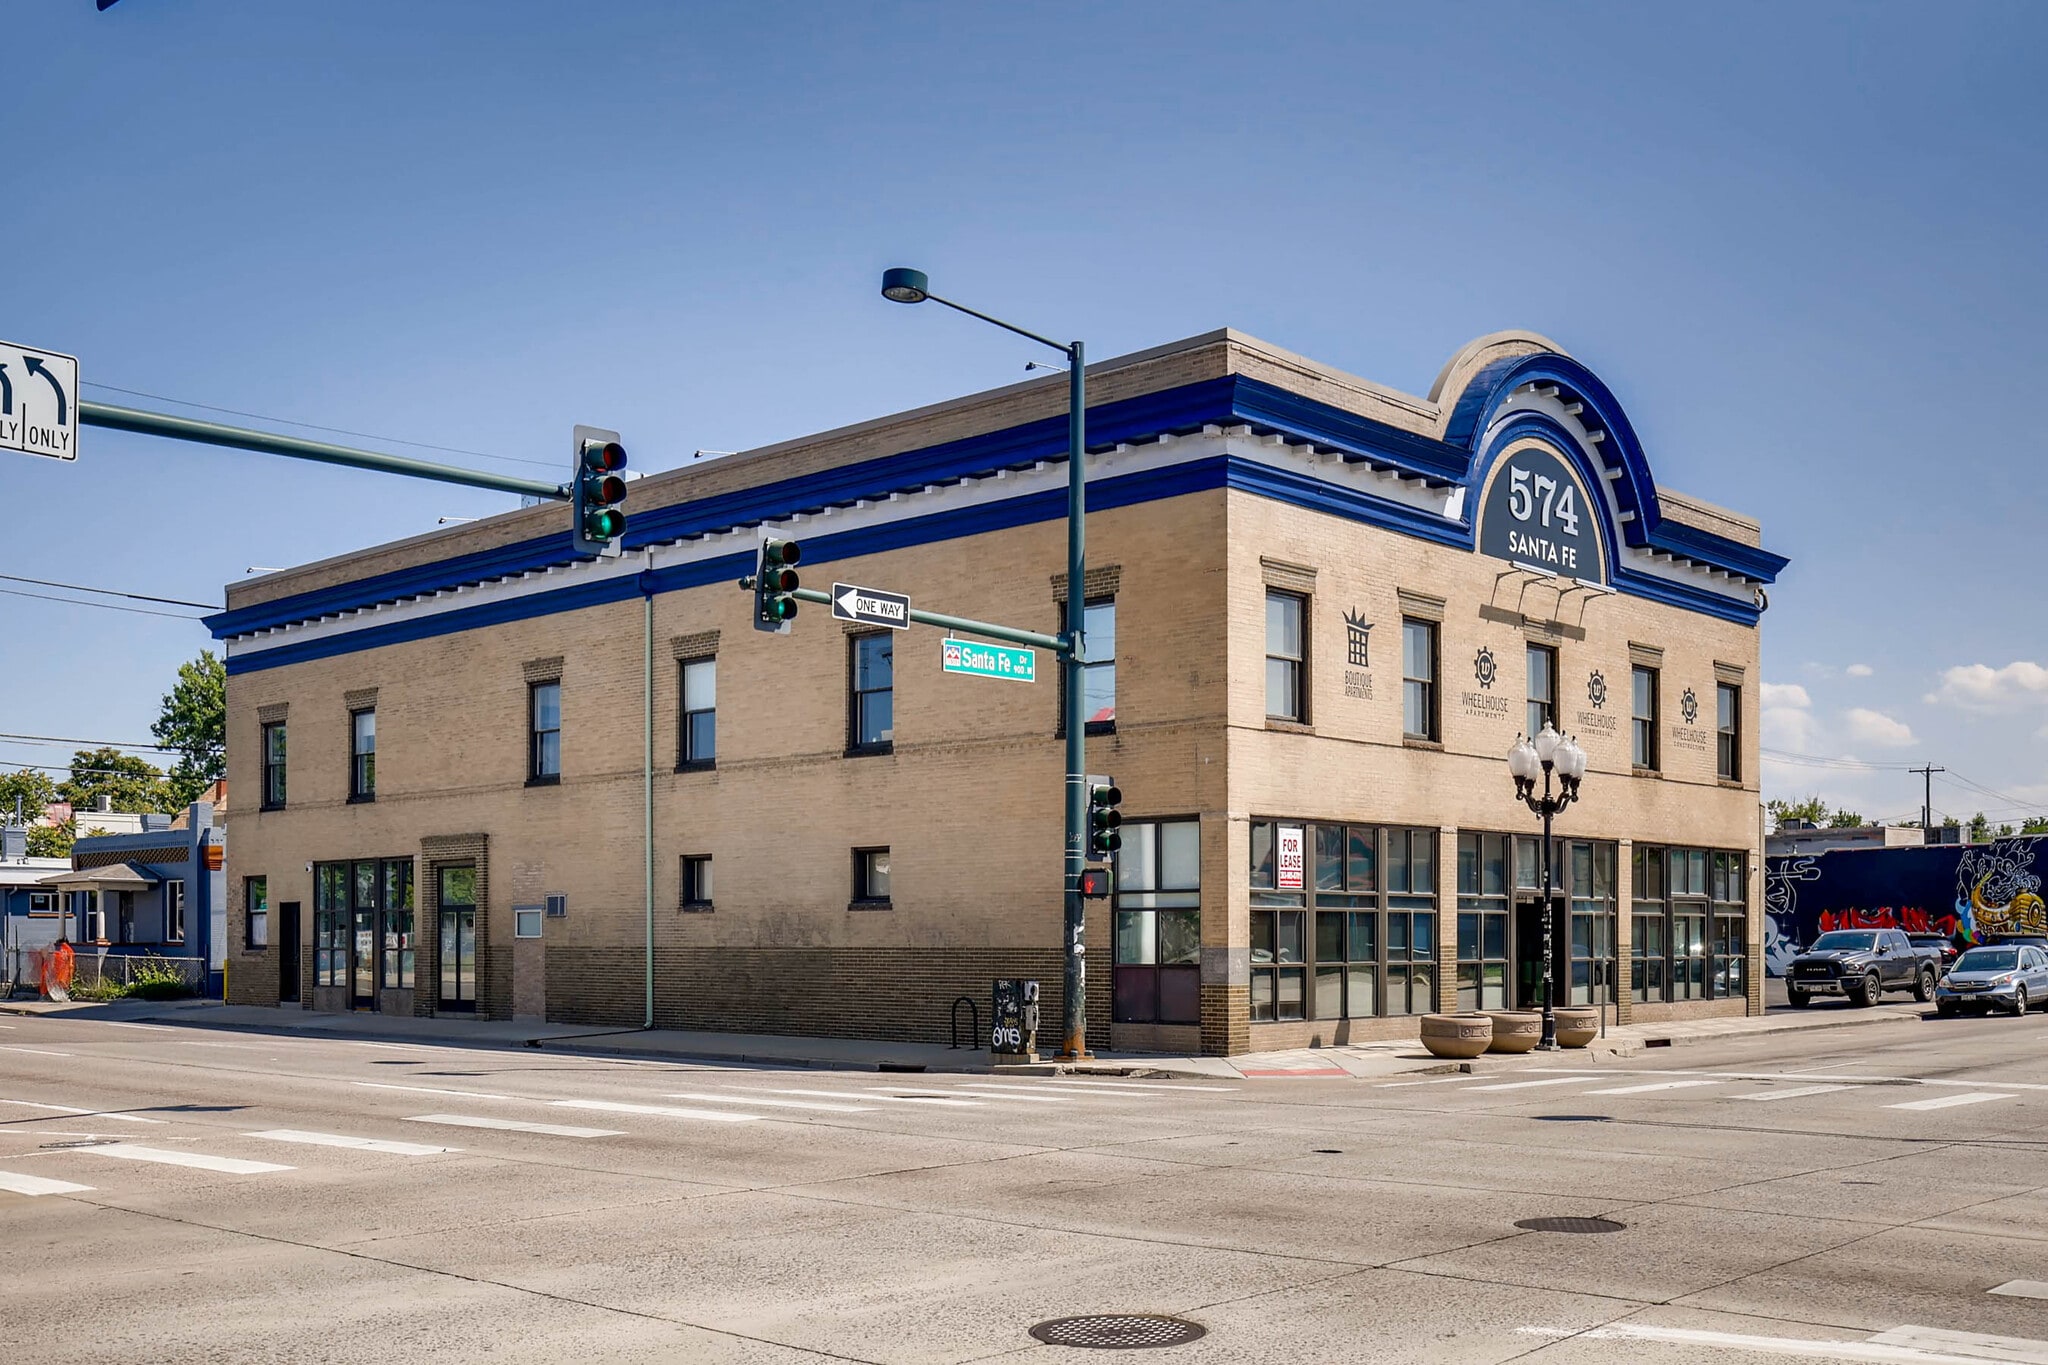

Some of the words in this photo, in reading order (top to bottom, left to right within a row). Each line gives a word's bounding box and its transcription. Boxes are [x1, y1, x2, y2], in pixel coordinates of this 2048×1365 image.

[29, 426, 69, 451] ONLY
[1508, 464, 1579, 536] 574
[1508, 530, 1558, 564] SANTA
[1562, 545, 1577, 569] FE
[856, 598, 877, 613] ONE
[880, 602, 901, 617] WAY
[962, 647, 995, 671] Santa
[998, 652, 1011, 673] Fe
[1019, 654, 1028, 664] Dr
[1013, 664, 1025, 674] 900
[1345, 670, 1372, 688] BOUTIQUE
[1345, 686, 1373, 701] APARTMENTS
[1461, 691, 1509, 713] WHEELHOUSE
[1466, 709, 1505, 721] APARTMENTS
[1577, 711, 1616, 731] WHEELHOUSE
[1672, 727, 1707, 745] WHEELHOUSE
[1282, 838, 1298, 852] FOR
[1280, 854, 1301, 868] LEASE
